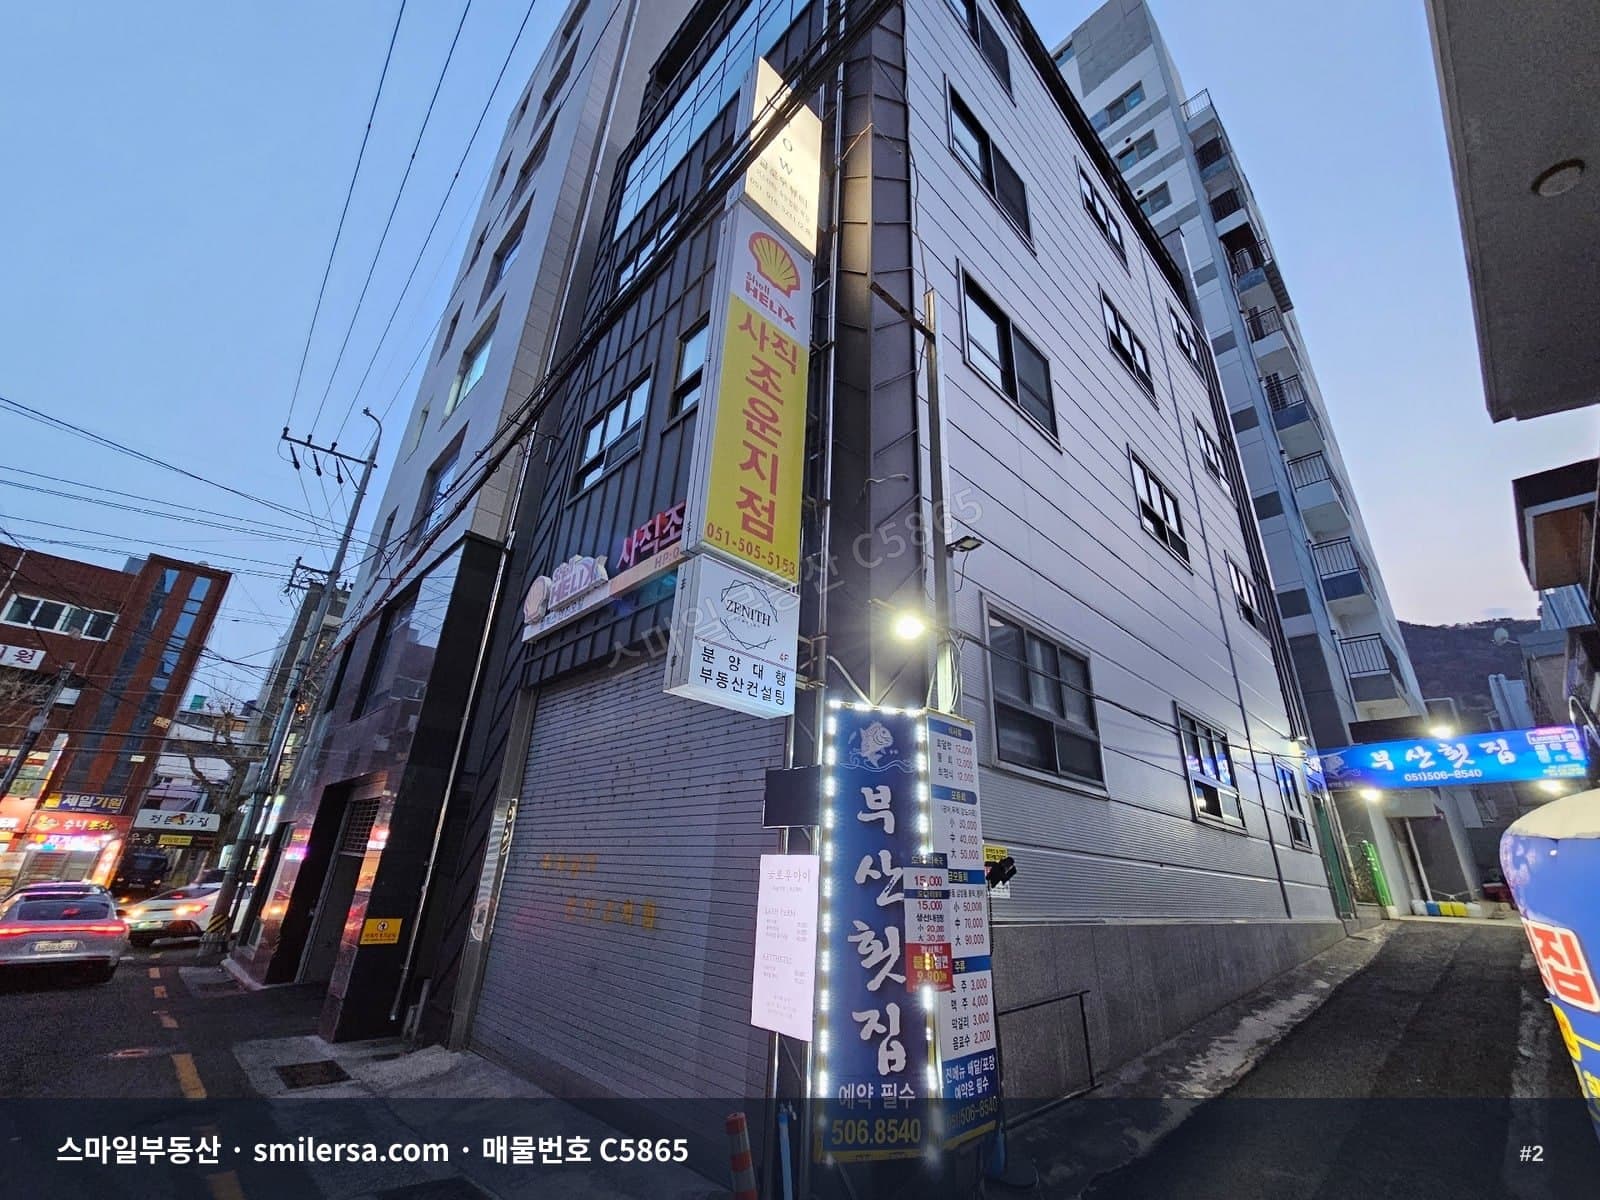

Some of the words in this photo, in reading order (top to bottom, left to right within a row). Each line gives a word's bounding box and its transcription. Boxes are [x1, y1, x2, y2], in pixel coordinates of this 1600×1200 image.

[746, 271, 770, 296] Shell
[745, 282, 797, 331] HELIX
[707, 520, 796, 576] 051-505-5153
[726, 599, 772, 627] ZENITH
[0, 646, 36, 664] 원
[699, 666, 786, 706] 부동산컨설팅
[1404, 768, 1483, 783] 051)506-8540
[63, 793, 120, 810] 제일기원
[963, 902, 983, 912] 50,000
[964, 917, 983, 930] 70,000
[964, 934, 985, 946] 90,000
[970, 978, 988, 992] 3,000
[971, 994, 989, 1008] 4,000
[972, 1012, 990, 1026] 3,000
[951, 1034, 971, 1050] 음료수
[974, 1030, 991, 1046] 2,000
[976, 1076, 990, 1095] 필수
[838, 1083, 874, 1109] 예약
[880, 1083, 916, 1109] 필수
[831, 1117, 921, 1145] 506.8540
